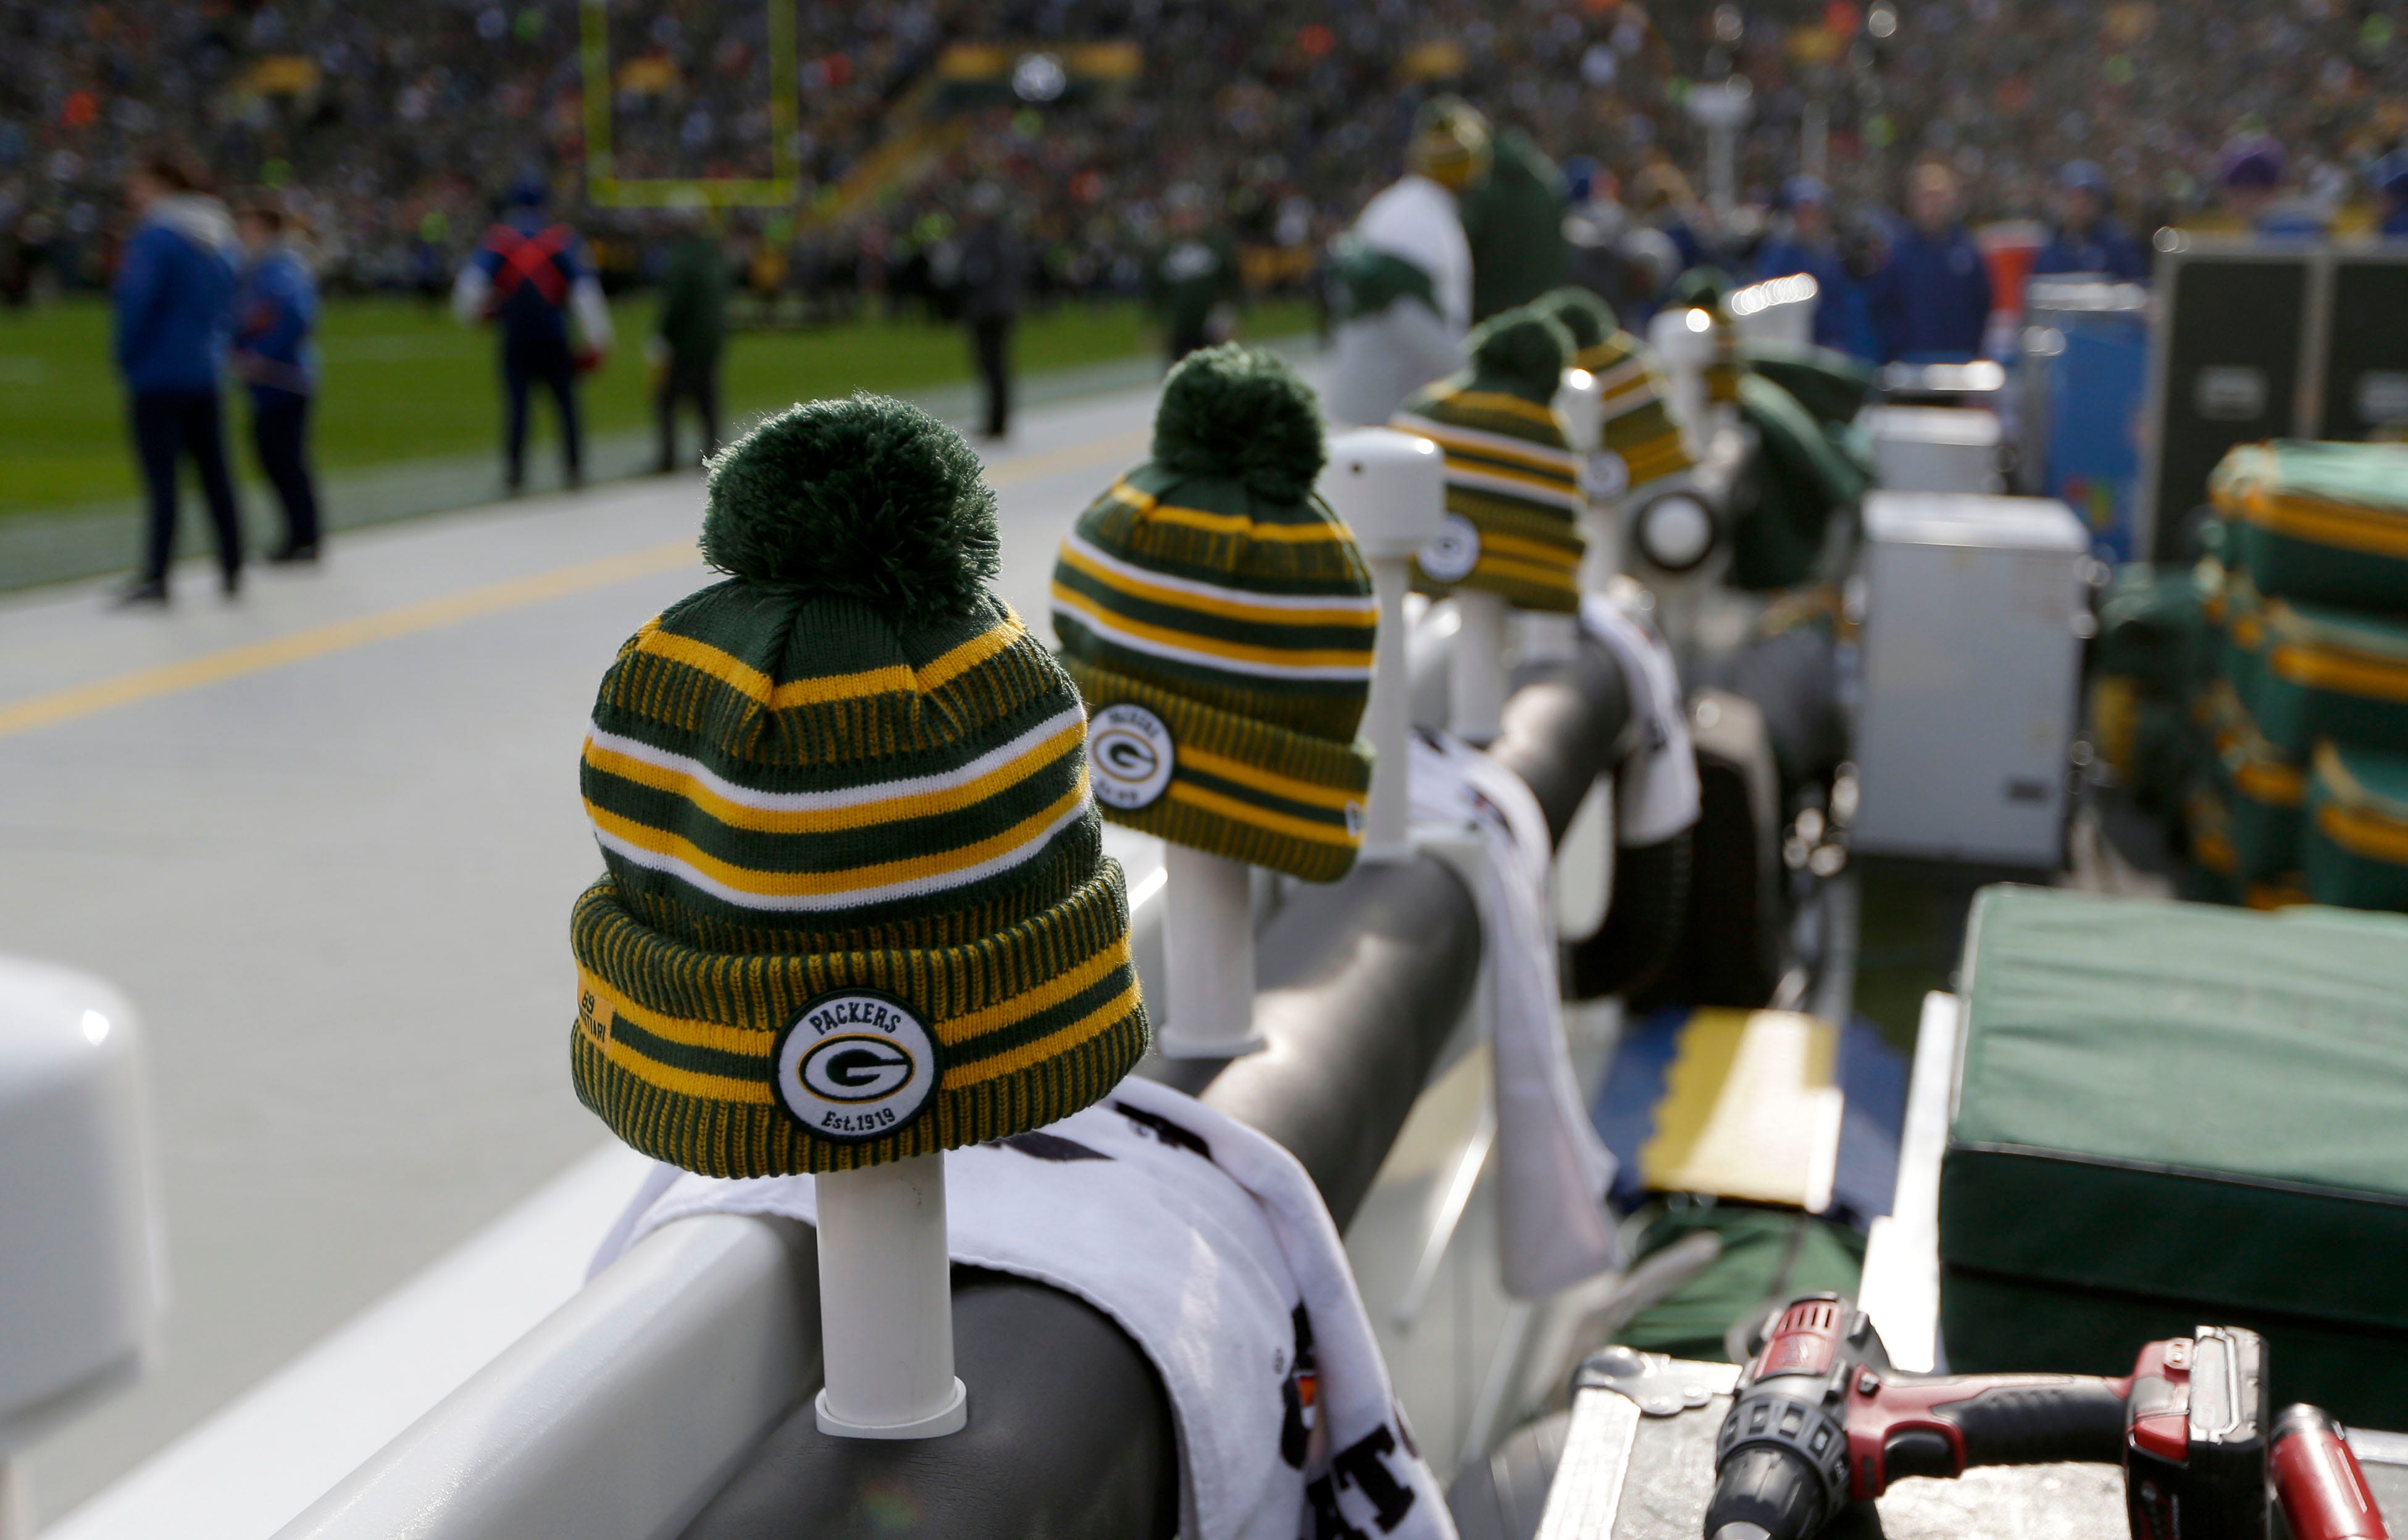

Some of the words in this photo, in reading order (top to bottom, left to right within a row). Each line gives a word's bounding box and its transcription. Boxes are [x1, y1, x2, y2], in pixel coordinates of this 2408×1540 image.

[582, 989, 595, 1015] 69
[809, 1002, 901, 1036] PACKERS
[821, 1107, 895, 1131] Est.1919
